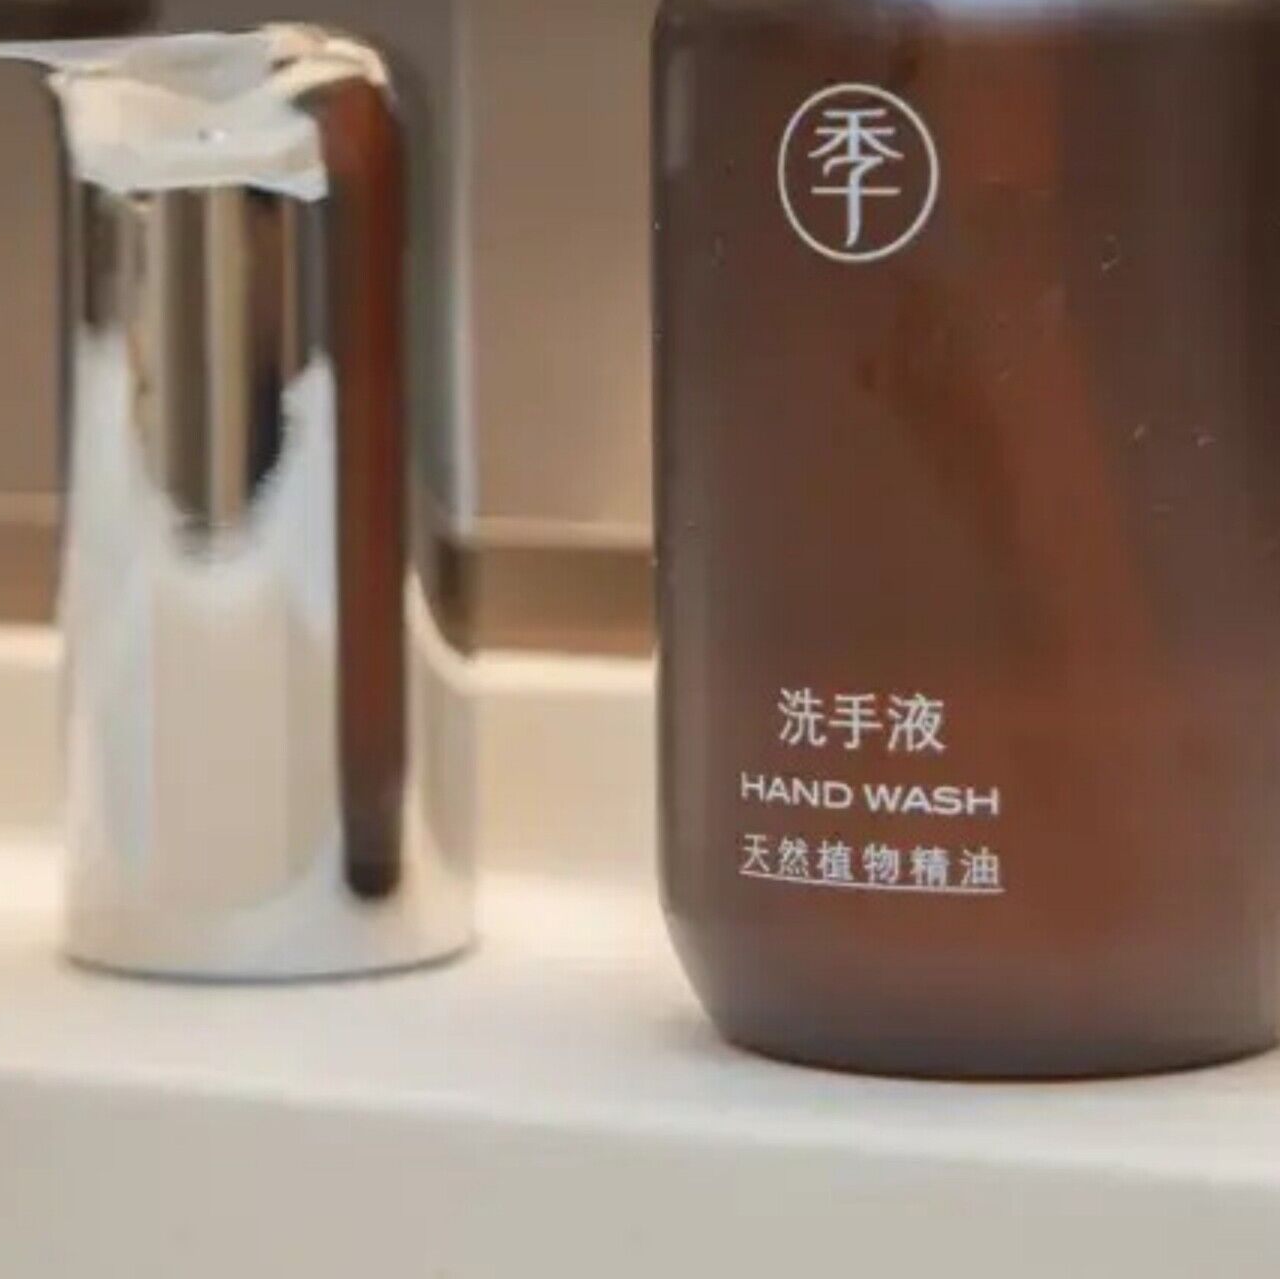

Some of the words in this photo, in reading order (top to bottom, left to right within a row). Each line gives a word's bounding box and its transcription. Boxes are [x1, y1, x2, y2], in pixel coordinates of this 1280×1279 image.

[807, 107, 905, 248] 季
[777, 686, 948, 753] 洗手液
[739, 771, 854, 809] HAND
[863, 783, 1001, 816] WASH
[740, 832, 1001, 888] 天然植物精油
